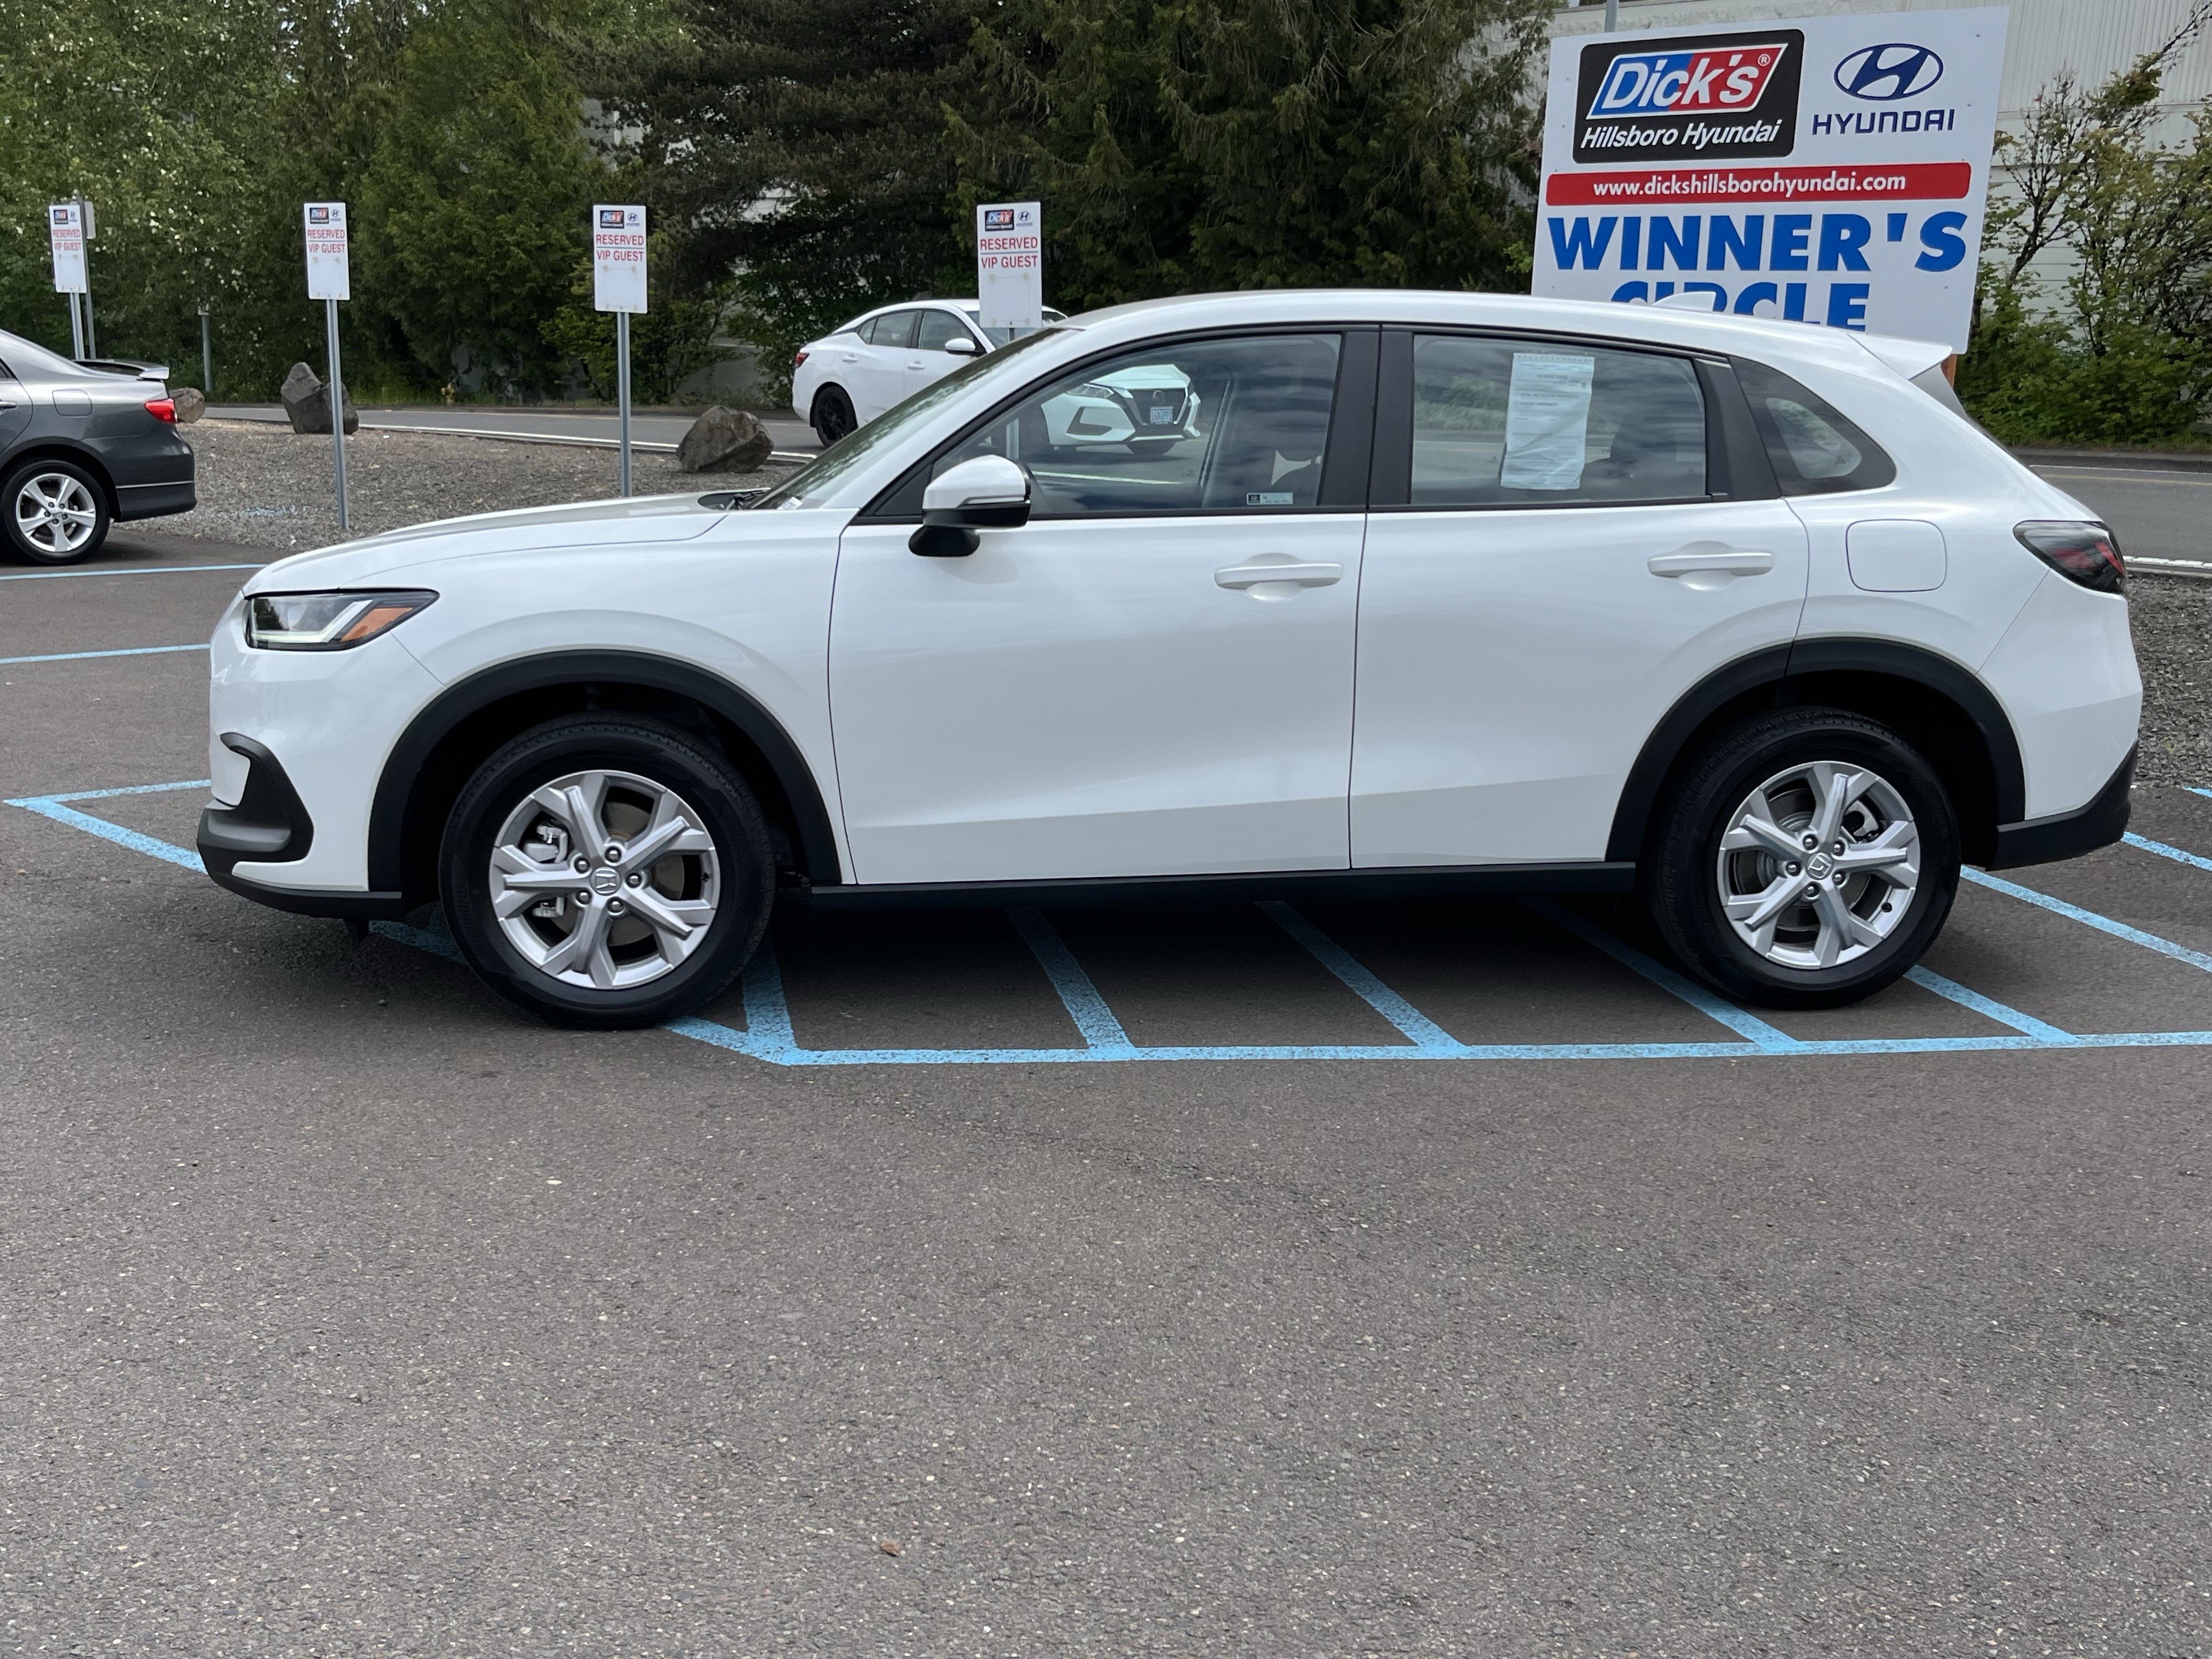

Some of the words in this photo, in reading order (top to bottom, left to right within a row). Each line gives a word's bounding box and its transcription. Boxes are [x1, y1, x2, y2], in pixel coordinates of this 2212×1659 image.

[1812, 109, 1955, 136] HYUNDAI
[1580, 125, 1679, 149] Hillsboro
[1681, 119, 1782, 150] Hyundai
[1593, 172, 1906, 198] www.dickshillsborohyundai.com
[307, 229, 345, 239] RESERVED
[596, 234, 644, 246] RESERVED
[1547, 211, 1968, 272] WINNER'S
[308, 244, 320, 253] VIP
[321, 244, 346, 253] GUEST
[980, 236, 1039, 251] RESERVED
[597, 250, 611, 261] VIP
[613, 251, 644, 262] GUEST
[981, 256, 998, 269] VIP
[1001, 256, 1039, 268] GUEST
[1611, 281, 1870, 332] CLE
